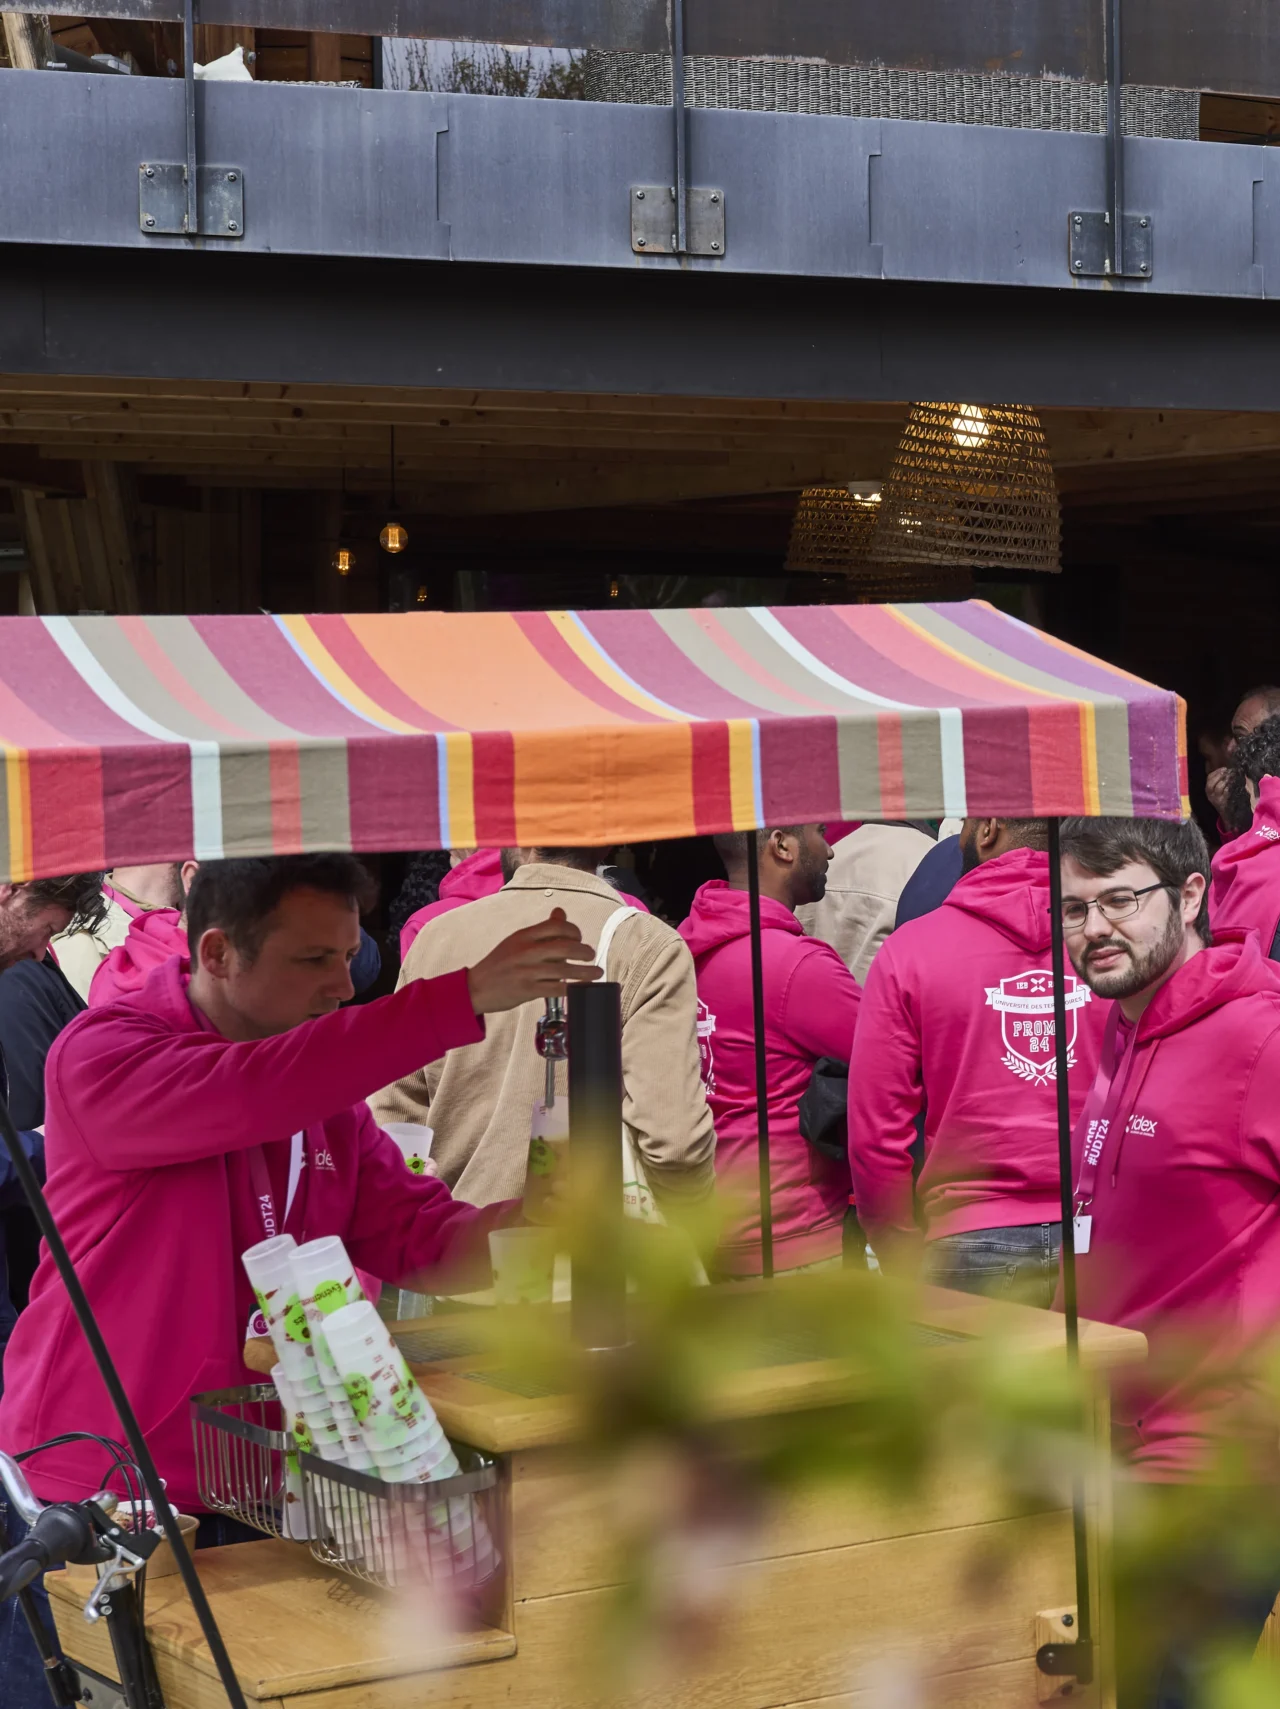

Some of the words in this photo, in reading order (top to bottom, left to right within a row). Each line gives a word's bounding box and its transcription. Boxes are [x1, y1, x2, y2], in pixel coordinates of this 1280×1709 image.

[1013, 1020, 1056, 1037] PROM
[1029, 1036, 1050, 1053] 24
[1131, 1115, 1157, 1133] idex
[1087, 1118, 1110, 1166] #UDT24
[315, 1148, 335, 1168] ide
[259, 1194, 276, 1238] UDT24
